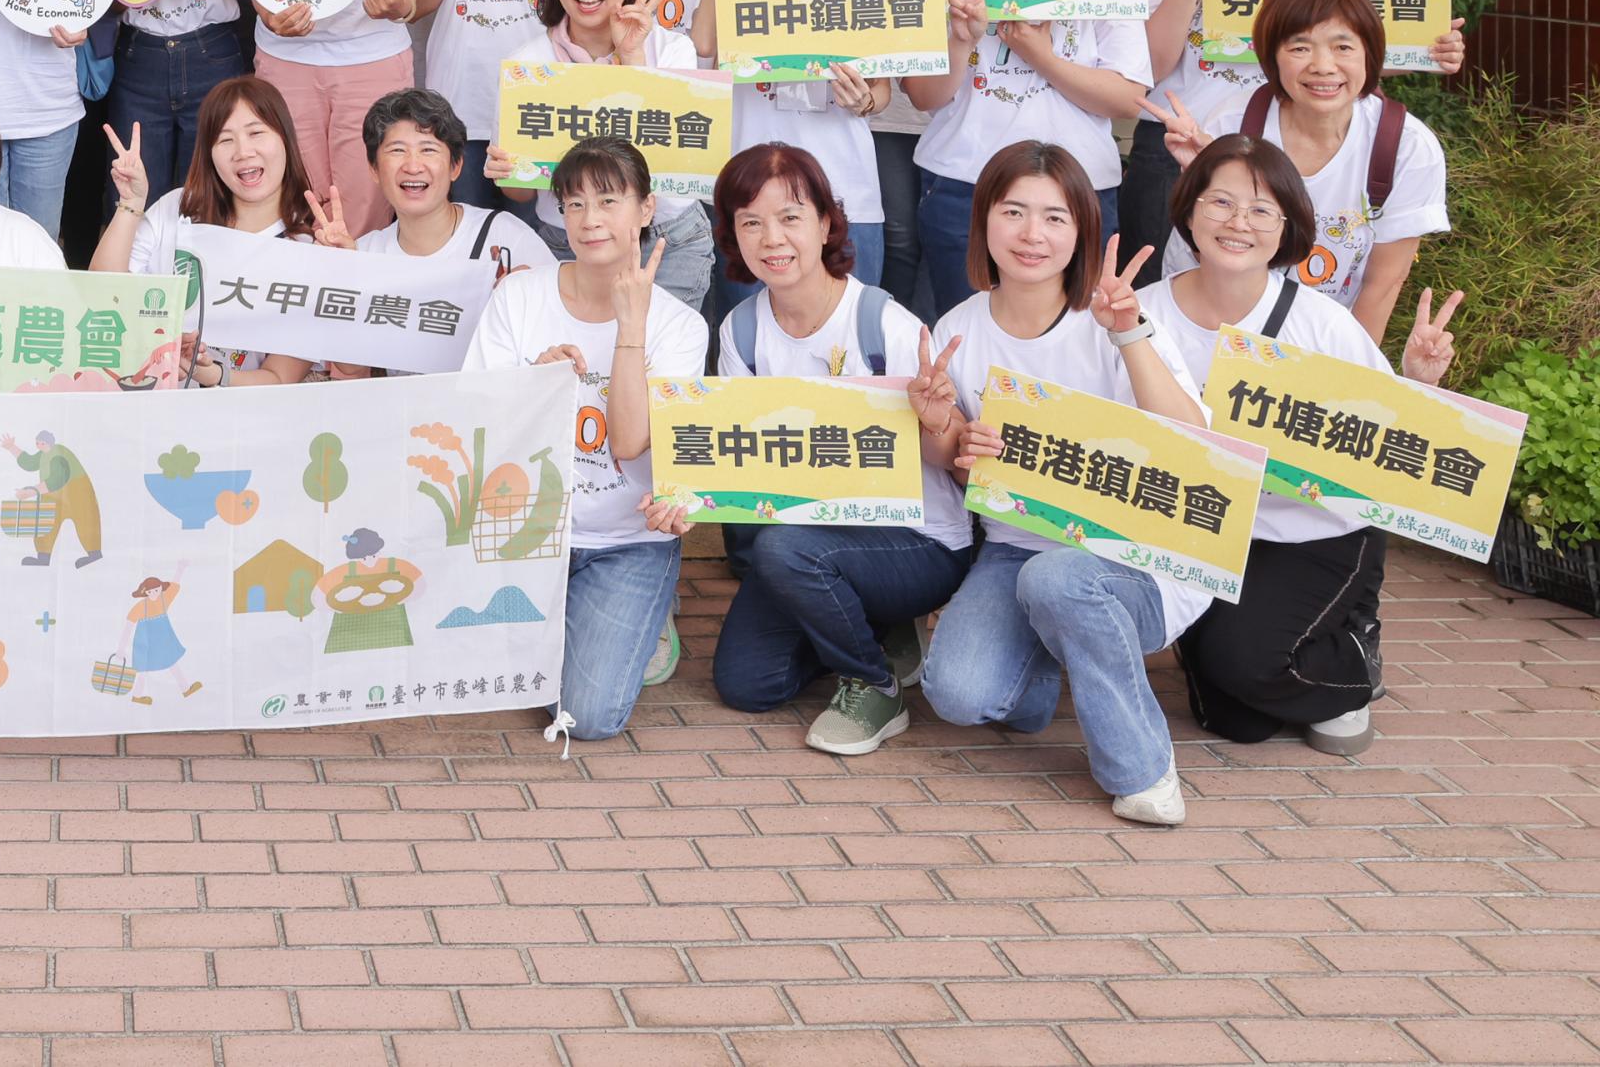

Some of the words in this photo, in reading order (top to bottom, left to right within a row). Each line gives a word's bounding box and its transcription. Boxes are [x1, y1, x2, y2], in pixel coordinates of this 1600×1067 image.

[37, 7, 93, 19] Economics
[517, 103, 712, 150] 草屯鎮農會
[212, 277, 464, 337] 大甲區農會
[671, 424, 898, 469] 臺中市農會
[1228, 379, 1486, 497] 竹塘鄉農會
[995, 422, 1232, 535] 鹿港鎮農會
[392, 671, 548, 706] 臺中市霧峰區農會
